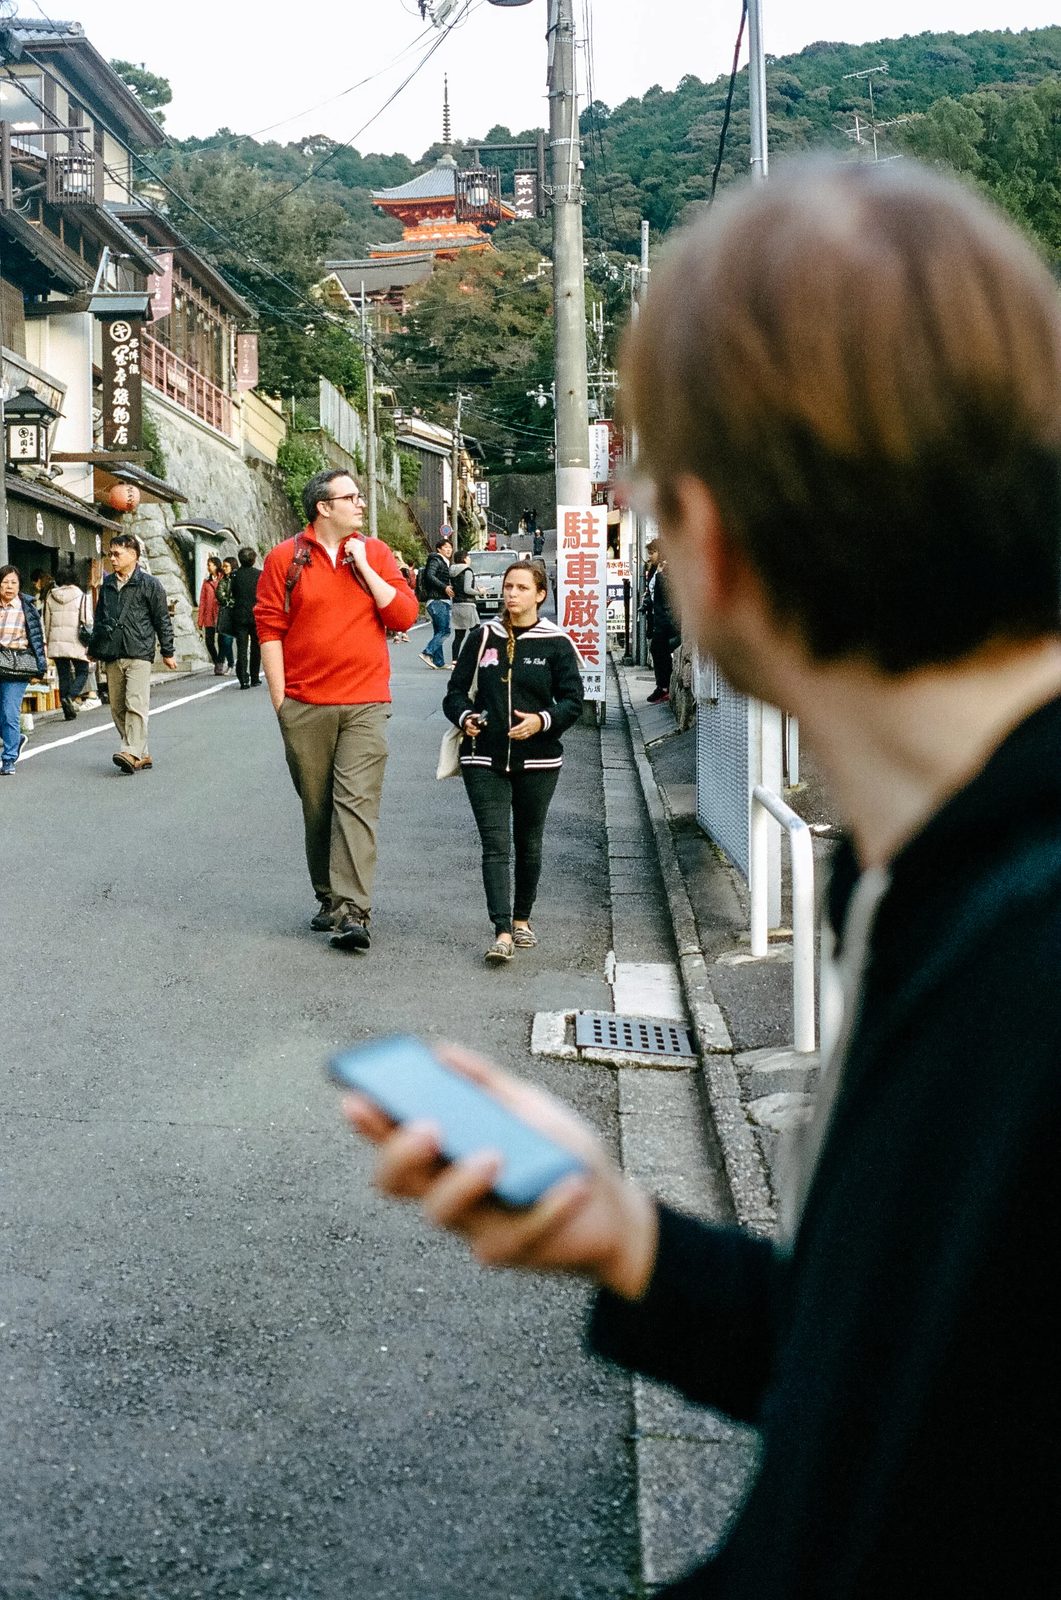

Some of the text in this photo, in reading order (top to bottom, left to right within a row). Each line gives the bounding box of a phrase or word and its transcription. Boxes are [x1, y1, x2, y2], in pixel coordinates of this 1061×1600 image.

[515, 174, 534, 219] 茶わん坂
[563, 511, 600, 665] 駐車厳禁
